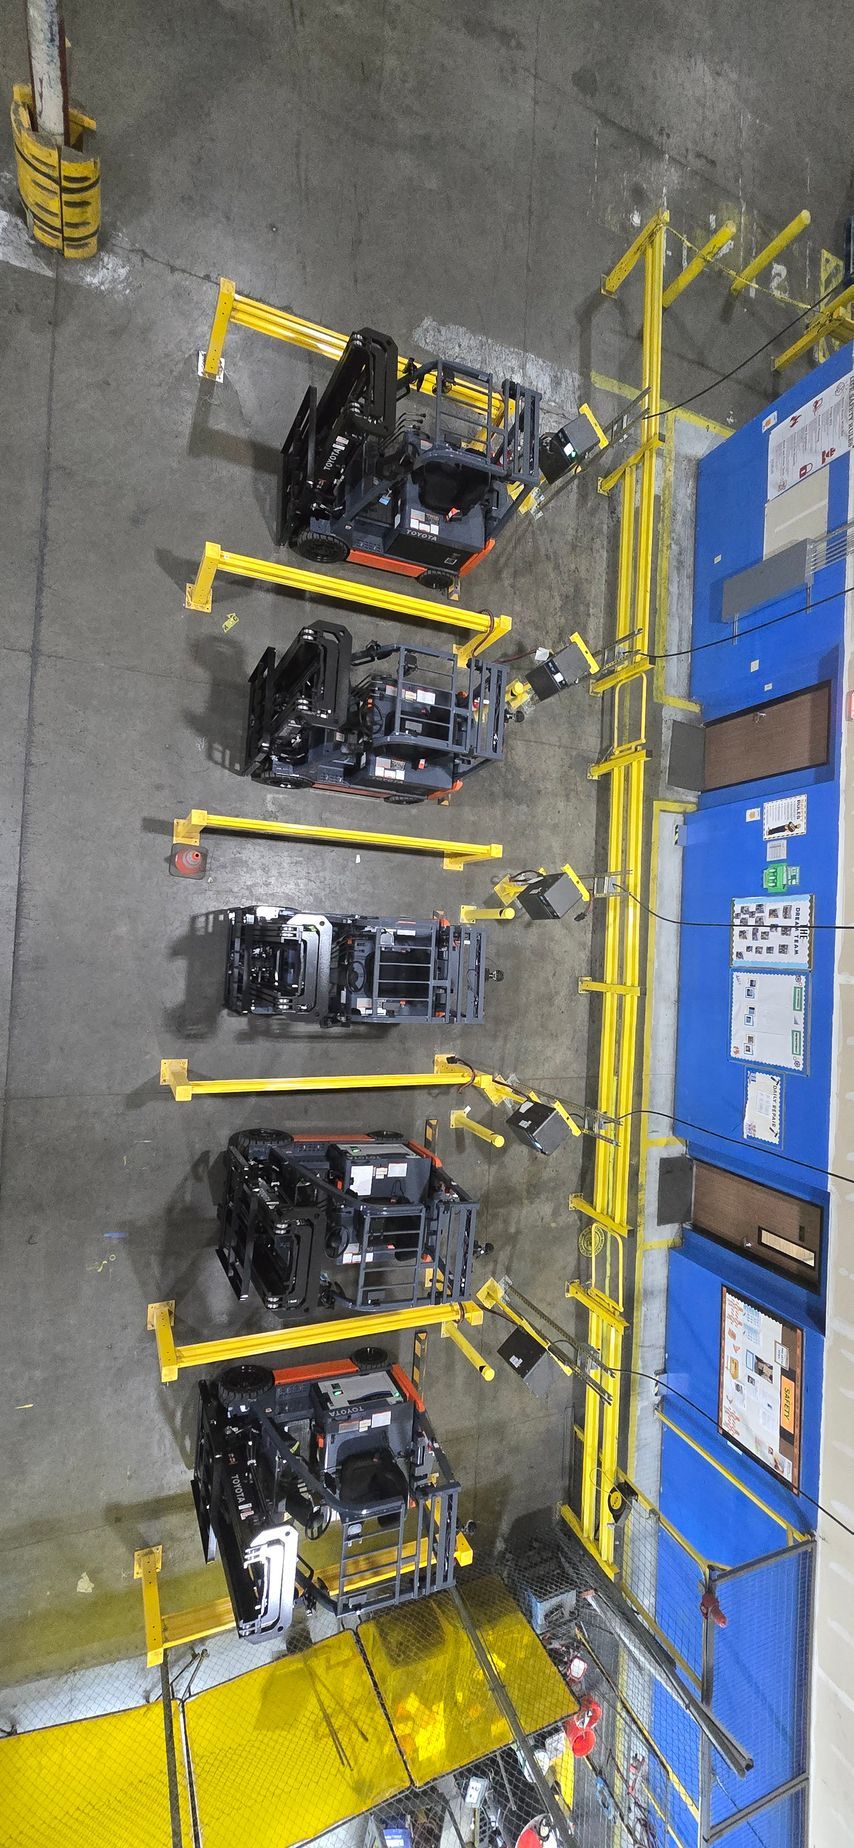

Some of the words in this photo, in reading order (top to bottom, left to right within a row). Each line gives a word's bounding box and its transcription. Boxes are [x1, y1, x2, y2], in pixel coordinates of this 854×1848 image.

[324, 449, 341, 470] TOYOTA
[406, 530, 437, 541] TOYOTA
[799, 924, 808, 940] THE
[328, 1406, 364, 1417] TOYOTA
[231, 1474, 245, 1503] TOYOTA
